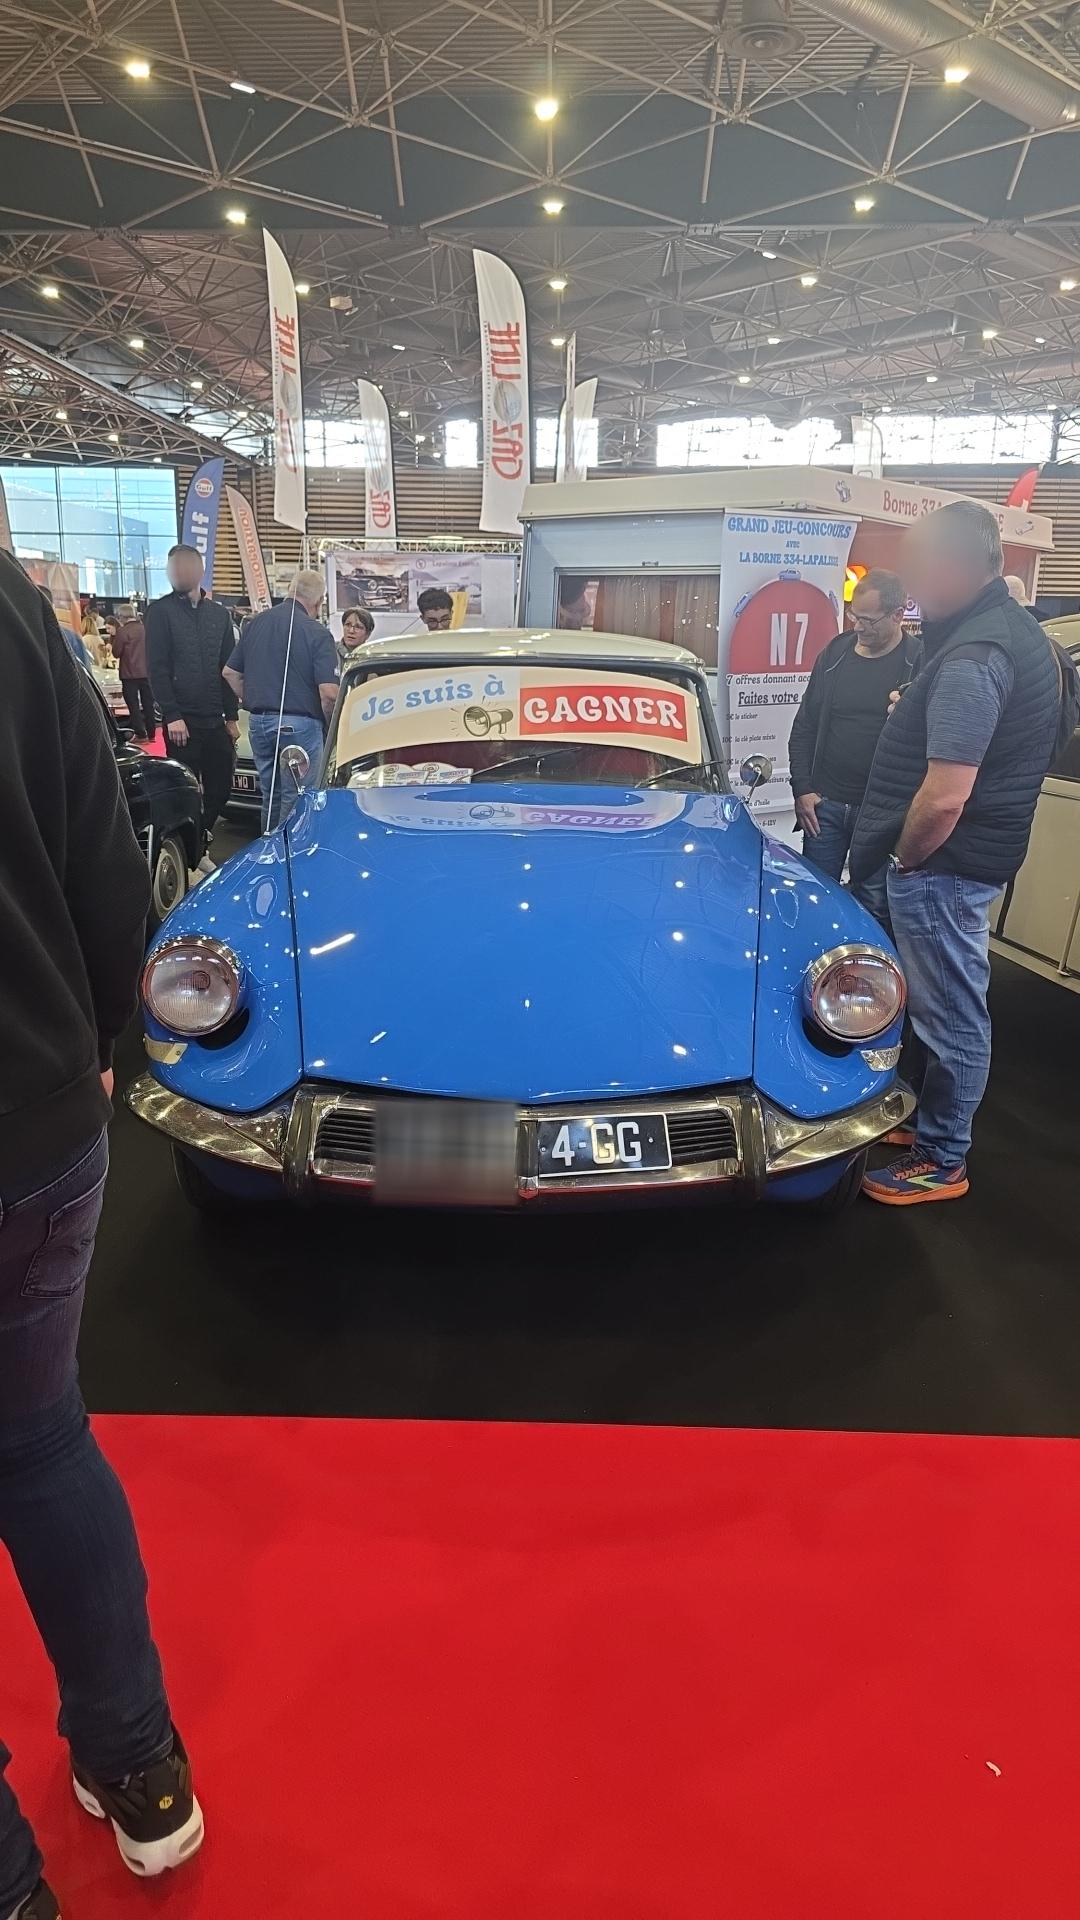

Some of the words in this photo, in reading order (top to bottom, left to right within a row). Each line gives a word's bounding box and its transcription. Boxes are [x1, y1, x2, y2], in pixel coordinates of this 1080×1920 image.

[883, 490, 918, 516] Borne
[727, 517, 769, 533] GRAND
[772, 519, 851, 539] JEU-CONCOURS
[785, 540, 800, 548] AVEC
[740, 552, 750, 562] LA
[752, 552, 782, 564] BORNE
[726, 674, 734, 685] 7
[735, 674, 761, 685] offres
[763, 674, 796, 684] donnant
[361, 697, 394, 721] Je
[406, 679, 473, 708] suis
[484, 674, 505, 696] à
[738, 691, 768, 705] Faites
[772, 690, 799, 703] votre
[523, 695, 683, 730] GAGNER
